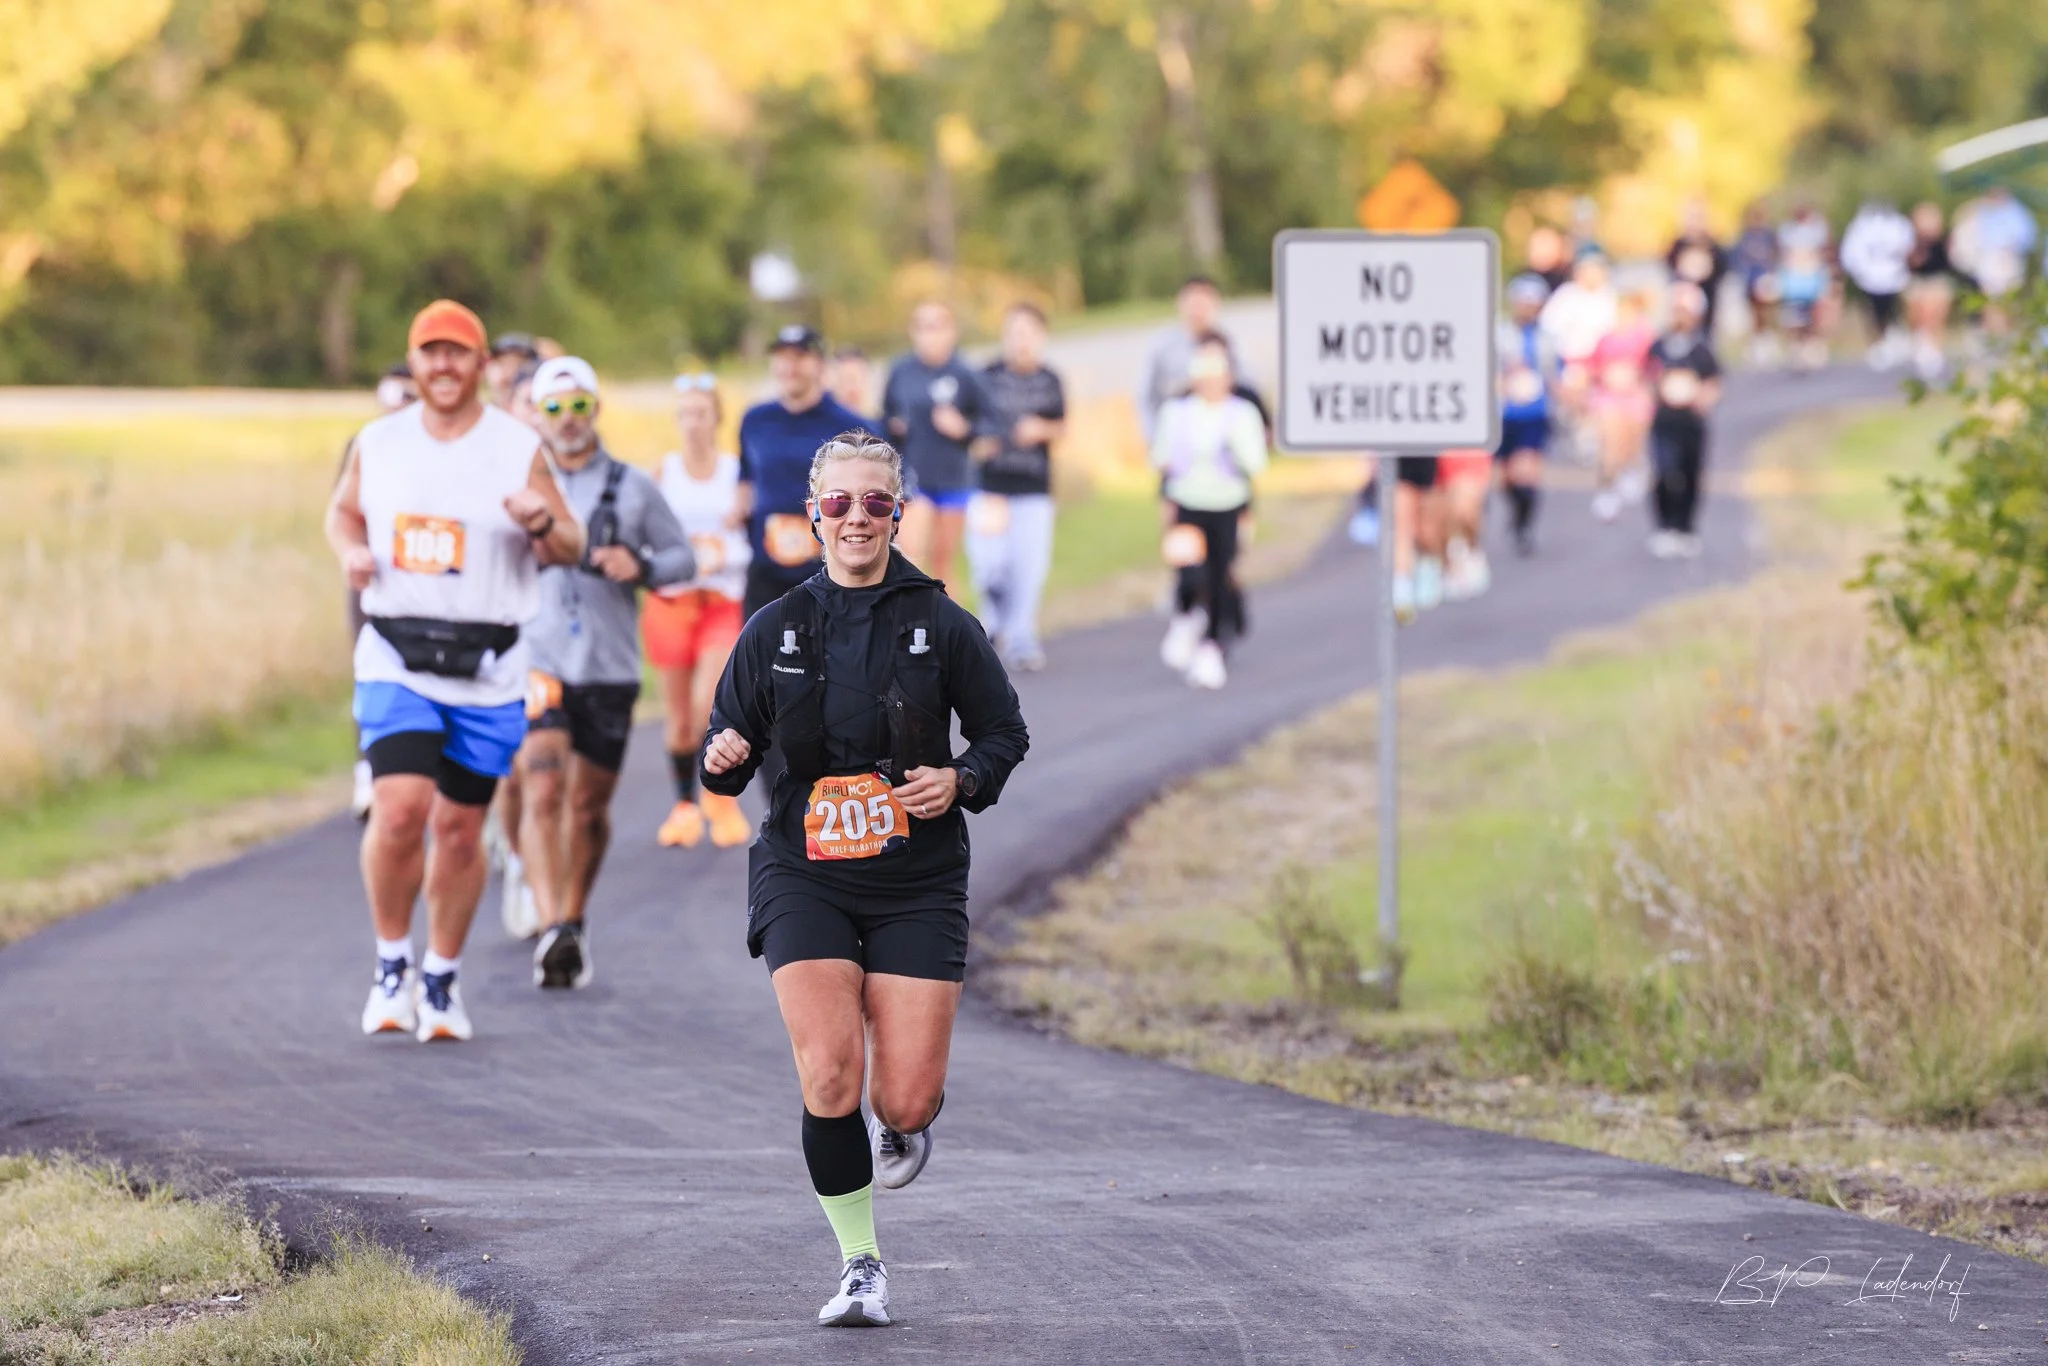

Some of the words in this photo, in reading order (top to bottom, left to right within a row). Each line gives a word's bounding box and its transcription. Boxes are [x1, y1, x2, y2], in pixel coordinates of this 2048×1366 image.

[1360, 262, 1413, 304] NO
[1318, 321, 1455, 363] MOTOR
[1309, 382, 1467, 423] VEHICLES
[772, 663, 805, 674] SALOMON
[815, 793, 895, 841] 205
[829, 844, 847, 854] HALF
[849, 839, 888, 853] MARATHON
